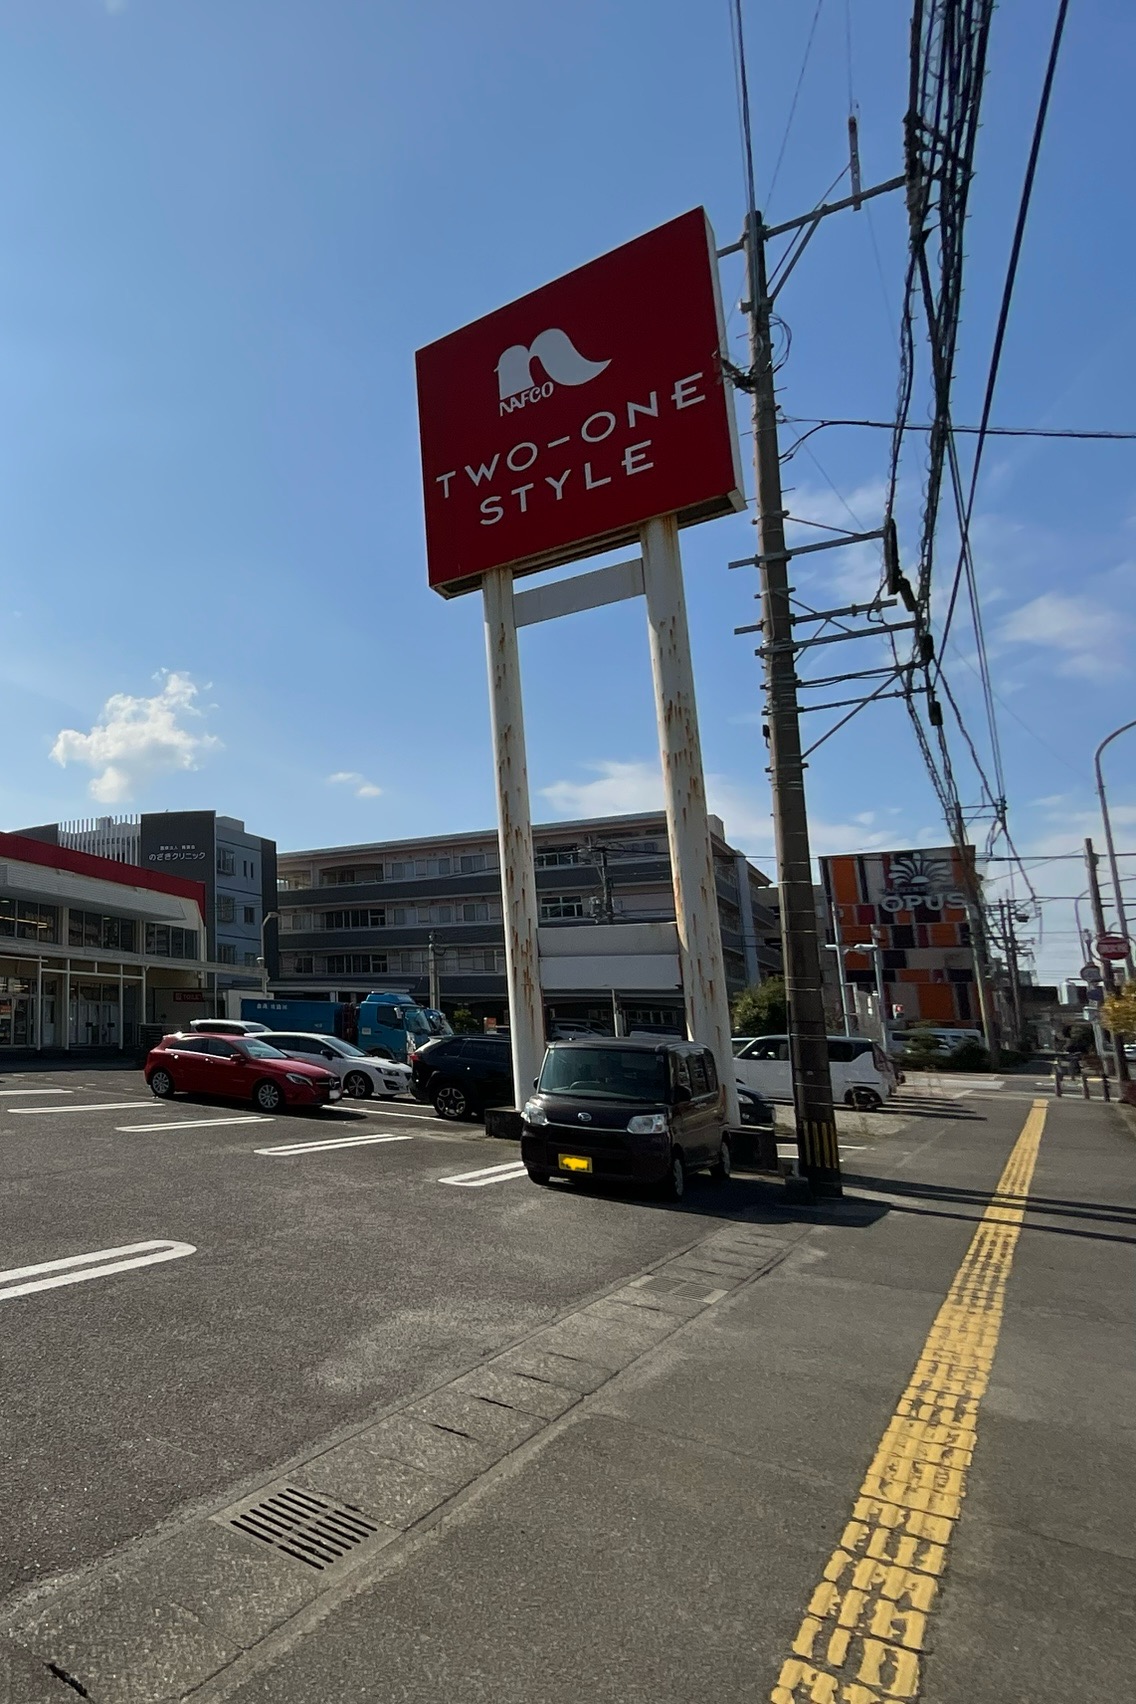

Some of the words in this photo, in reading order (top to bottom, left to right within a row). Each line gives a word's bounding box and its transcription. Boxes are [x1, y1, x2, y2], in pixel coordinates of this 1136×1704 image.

[499, 381, 554, 416] NAFCO
[435, 371, 706, 499] TWO-ONE
[479, 439, 655, 526] STYLE
[148, 851, 206, 861] のざきクリニック
[881, 892, 967, 912] OPUS
